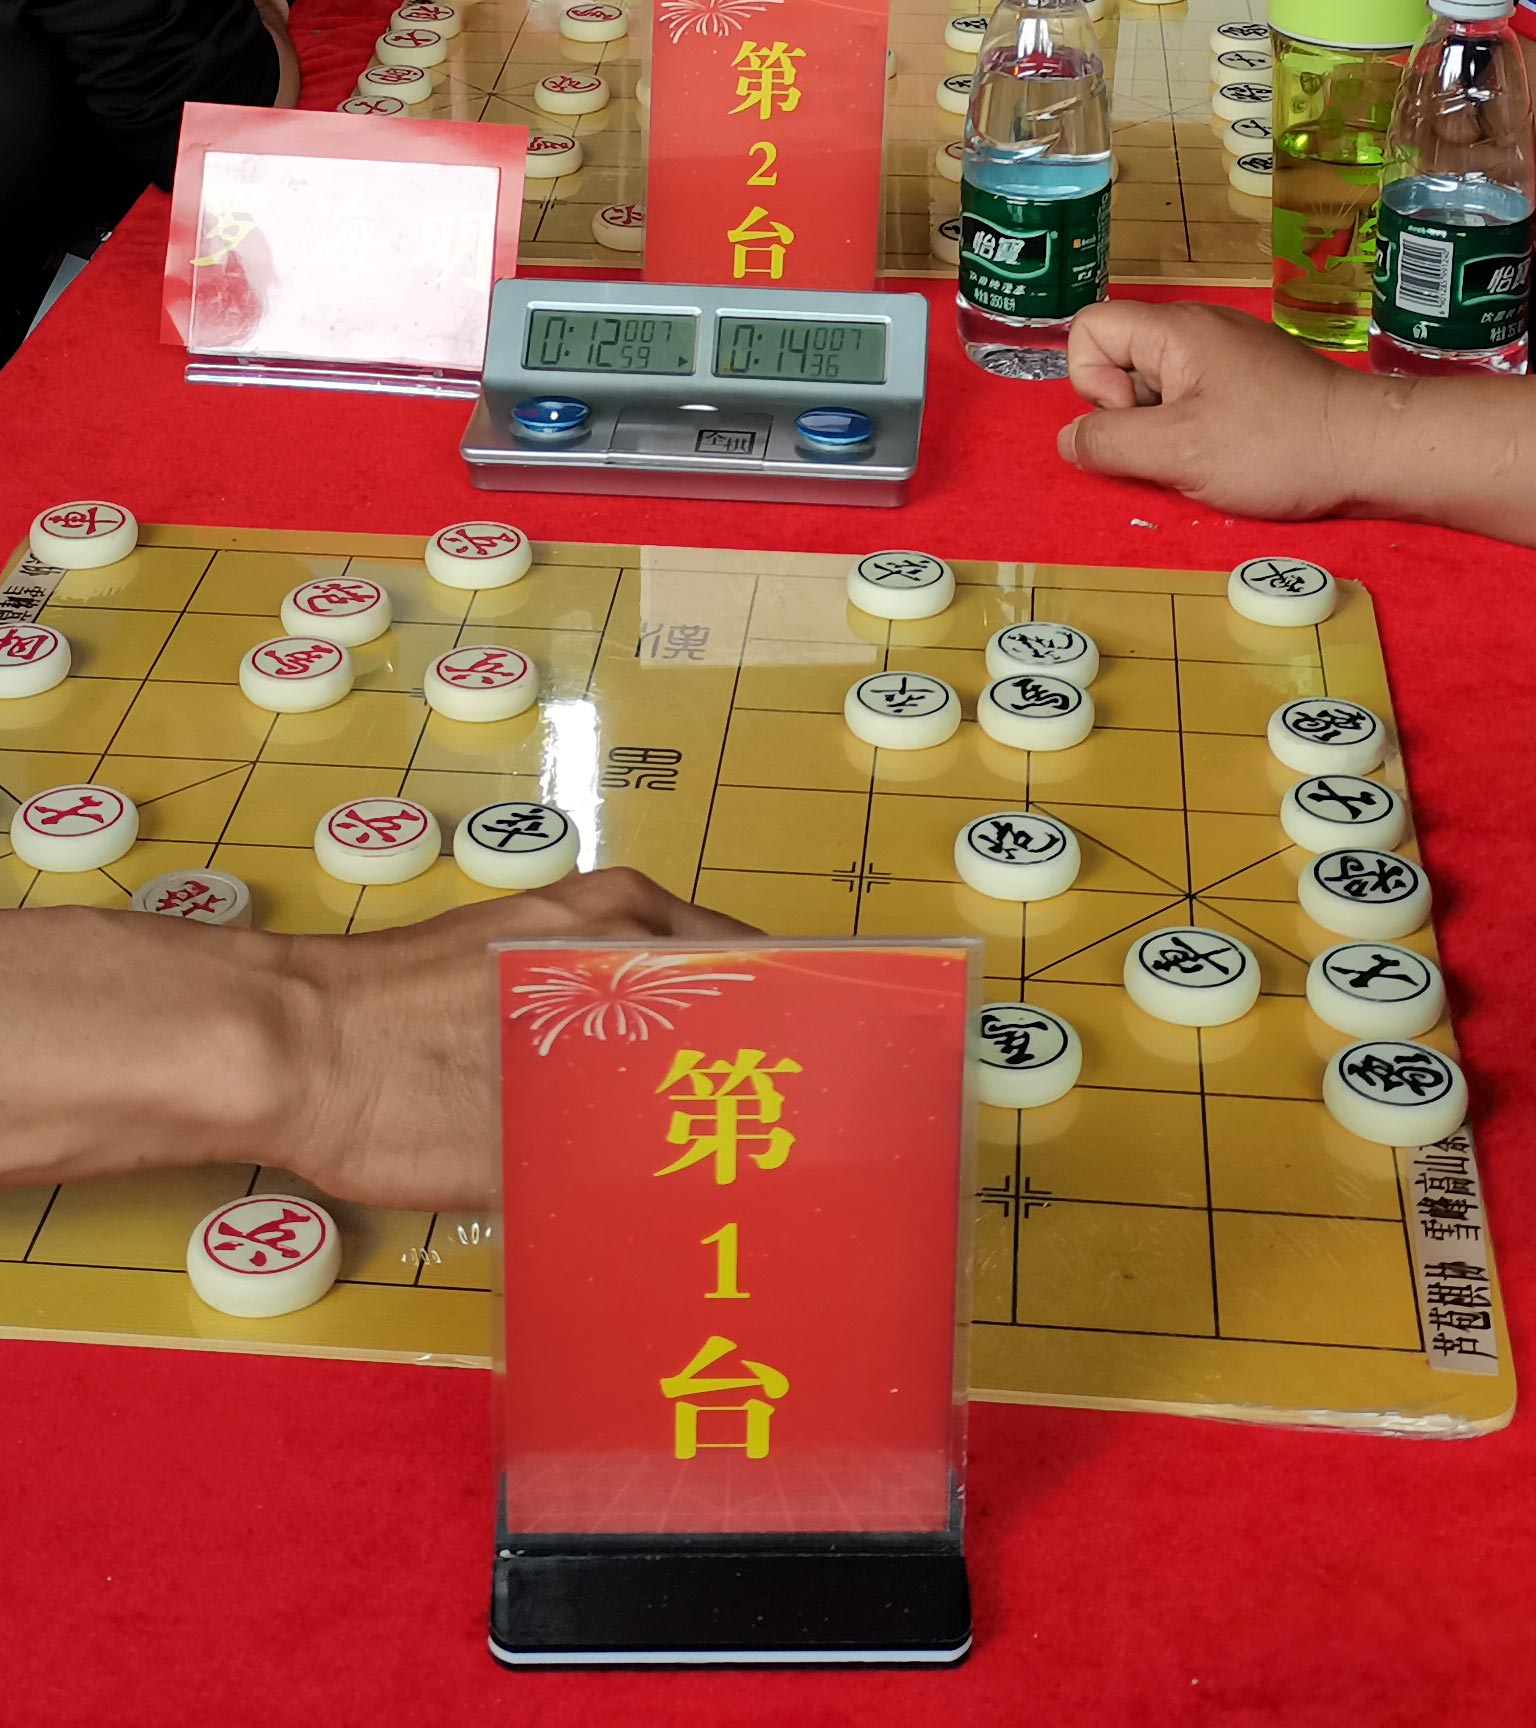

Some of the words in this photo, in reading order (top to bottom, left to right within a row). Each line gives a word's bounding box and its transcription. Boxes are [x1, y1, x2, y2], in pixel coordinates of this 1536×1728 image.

[727, 40, 806, 279] 第2台
[540, 316, 621, 369] 0:12
[622, 320, 672, 343] 007
[729, 324, 808, 374] 0:14
[812, 327, 861, 351] 007
[621, 346, 650, 369] 59
[654, 1048, 803, 1460] 第1台
